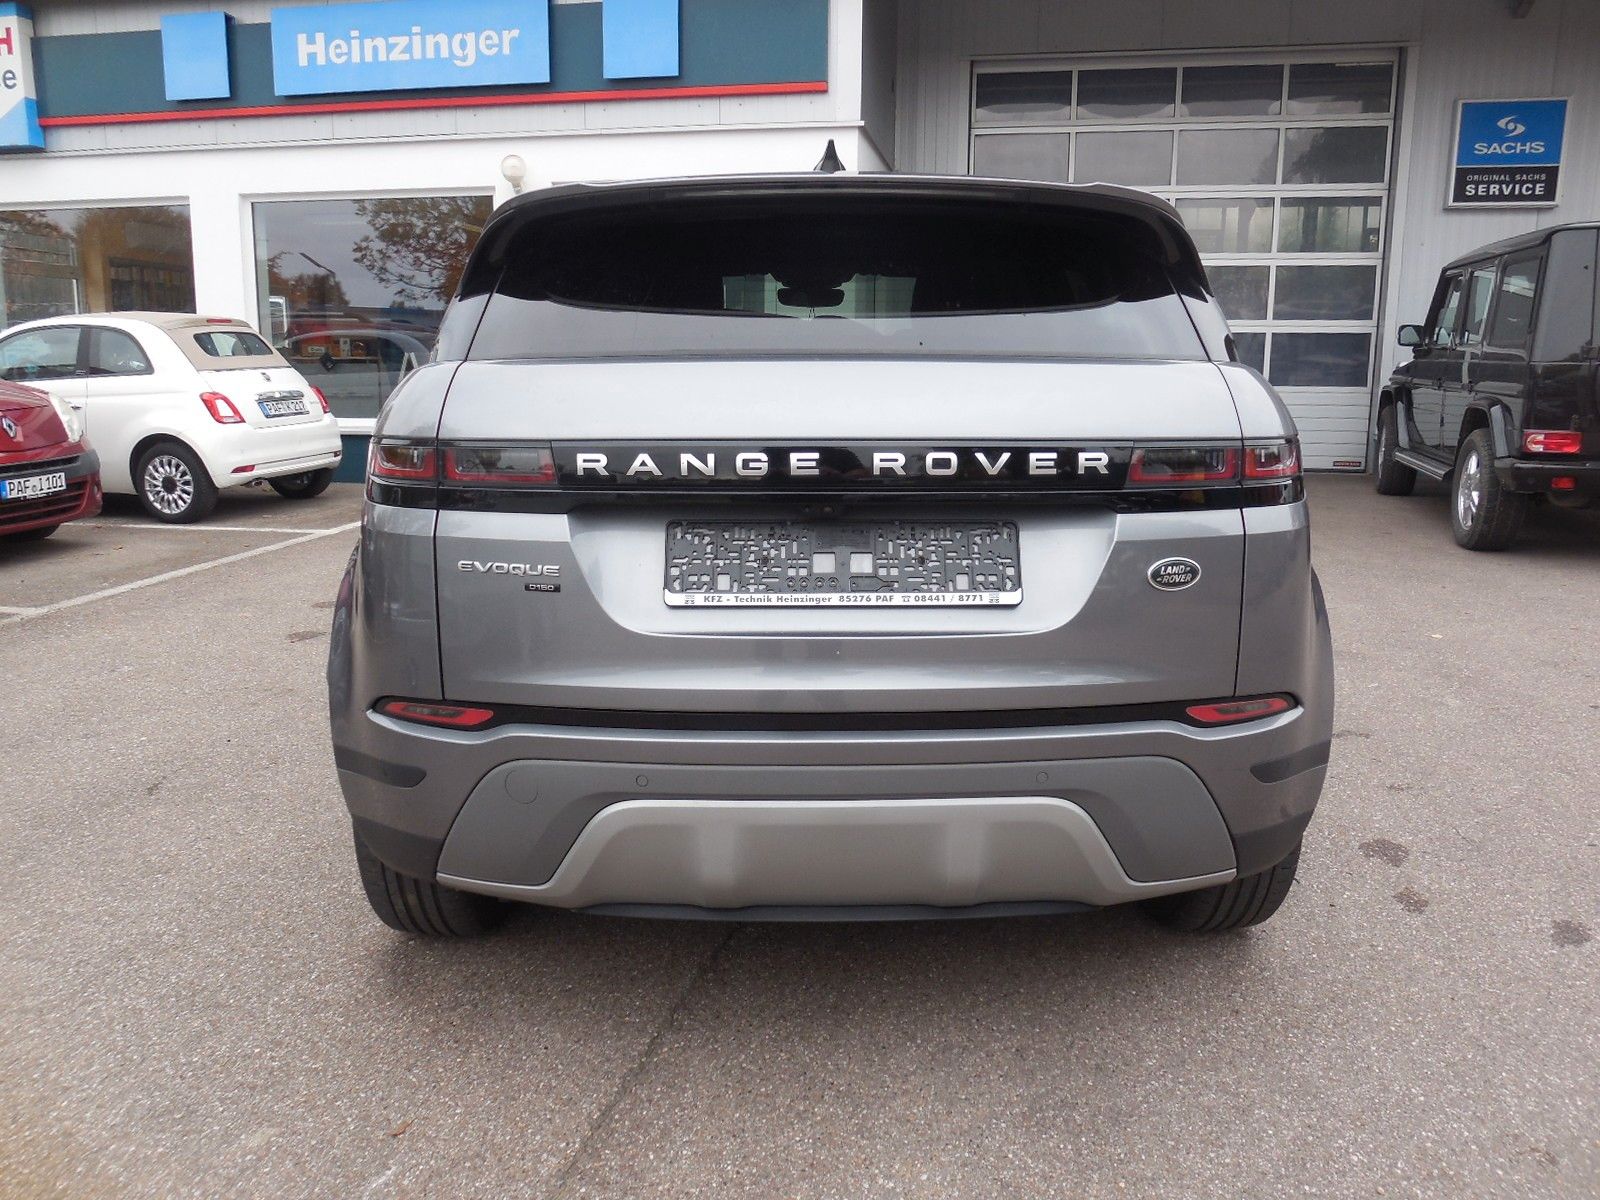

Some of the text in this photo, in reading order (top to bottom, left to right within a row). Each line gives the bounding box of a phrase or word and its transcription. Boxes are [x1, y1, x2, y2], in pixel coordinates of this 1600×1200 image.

[297, 26, 520, 67] Heinzinger
[1474, 141, 1546, 154] SACHS
[1466, 173, 1547, 182] ORIGINAL SACHS
[1465, 183, 1546, 196] SERVICE
[576, 452, 1109, 476] RANGE ROVER
[8, 479, 31, 496] PAF
[457, 559, 560, 577] EVOQUE
[1160, 565, 1186, 575] LAND
[1161, 573, 1193, 584] ROVER
[703, 595, 724, 604] KFZ
[734, 595, 773, 604] Technik
[776, 595, 833, 605] Heinzinger
[838, 595, 872, 603] 85276
[875, 595, 895, 603] PAF
[914, 594, 946, 602] 08441
[958, 594, 984, 602] 8771
